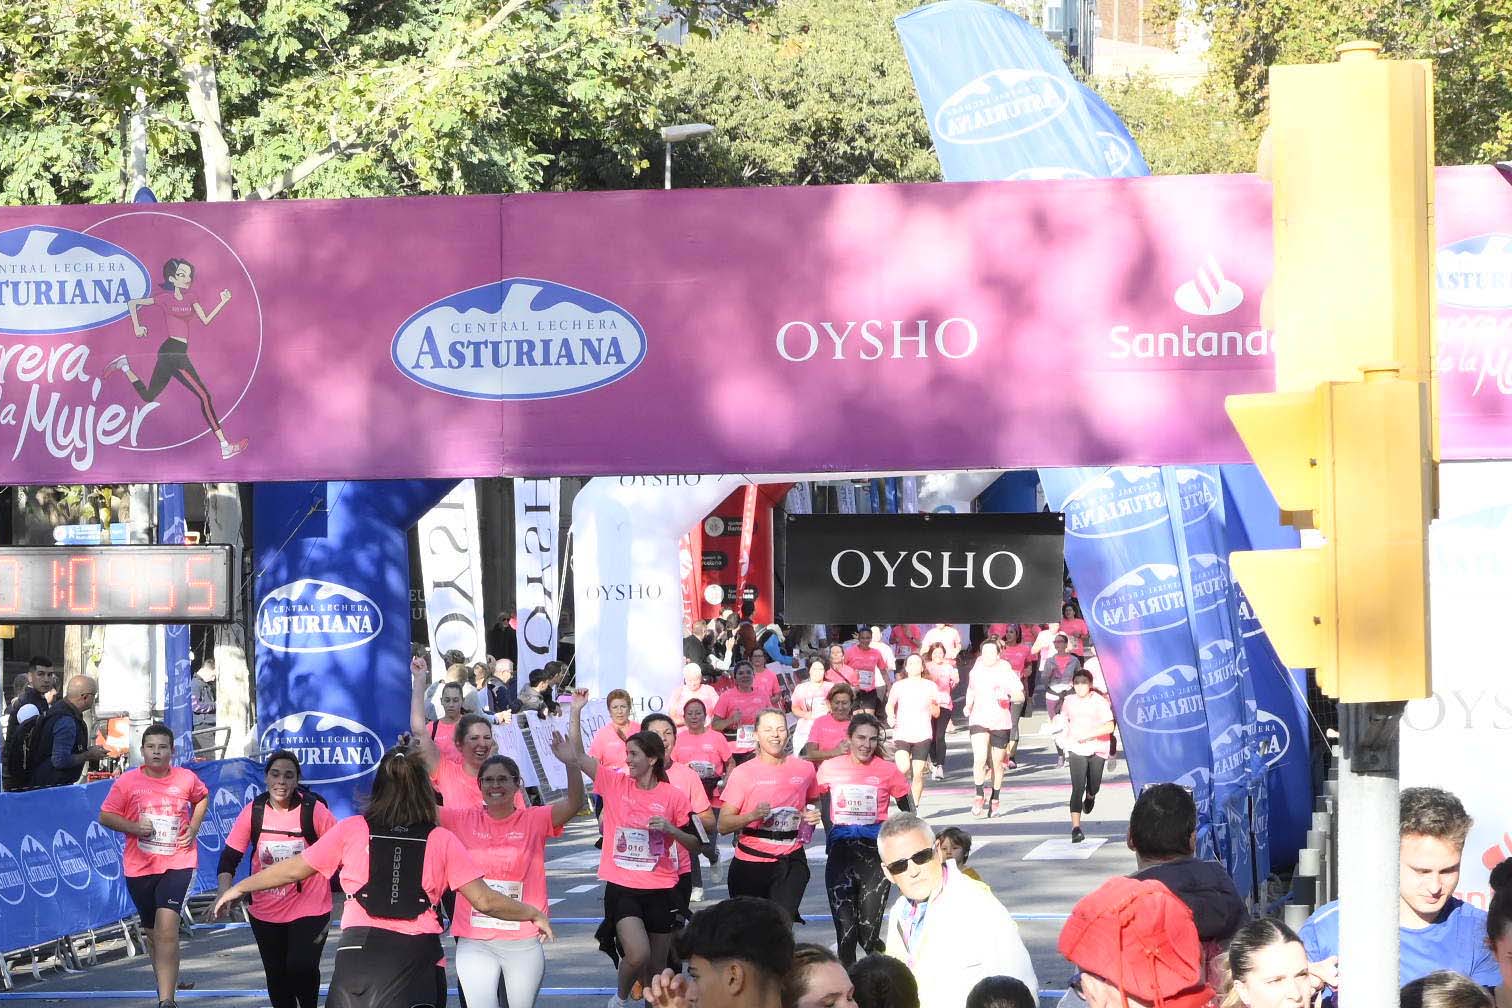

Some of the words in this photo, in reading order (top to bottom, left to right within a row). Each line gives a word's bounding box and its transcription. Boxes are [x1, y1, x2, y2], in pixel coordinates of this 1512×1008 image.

[54, 261, 126, 273] LECHERA
[450, 320, 529, 334] CENTRAL
[537, 318, 618, 331] LECHERA
[775, 317, 979, 362] OYSHO
[1108, 325, 1275, 358] Santand
[411, 326, 627, 370] ASTURIANA
[11, 377, 161, 472] Mujer
[830, 548, 1024, 590] OYSHO
[260, 610, 374, 637] ASTURIANA
[273, 604, 317, 613] CENTRAL
[320, 603, 369, 612] LECHERA
